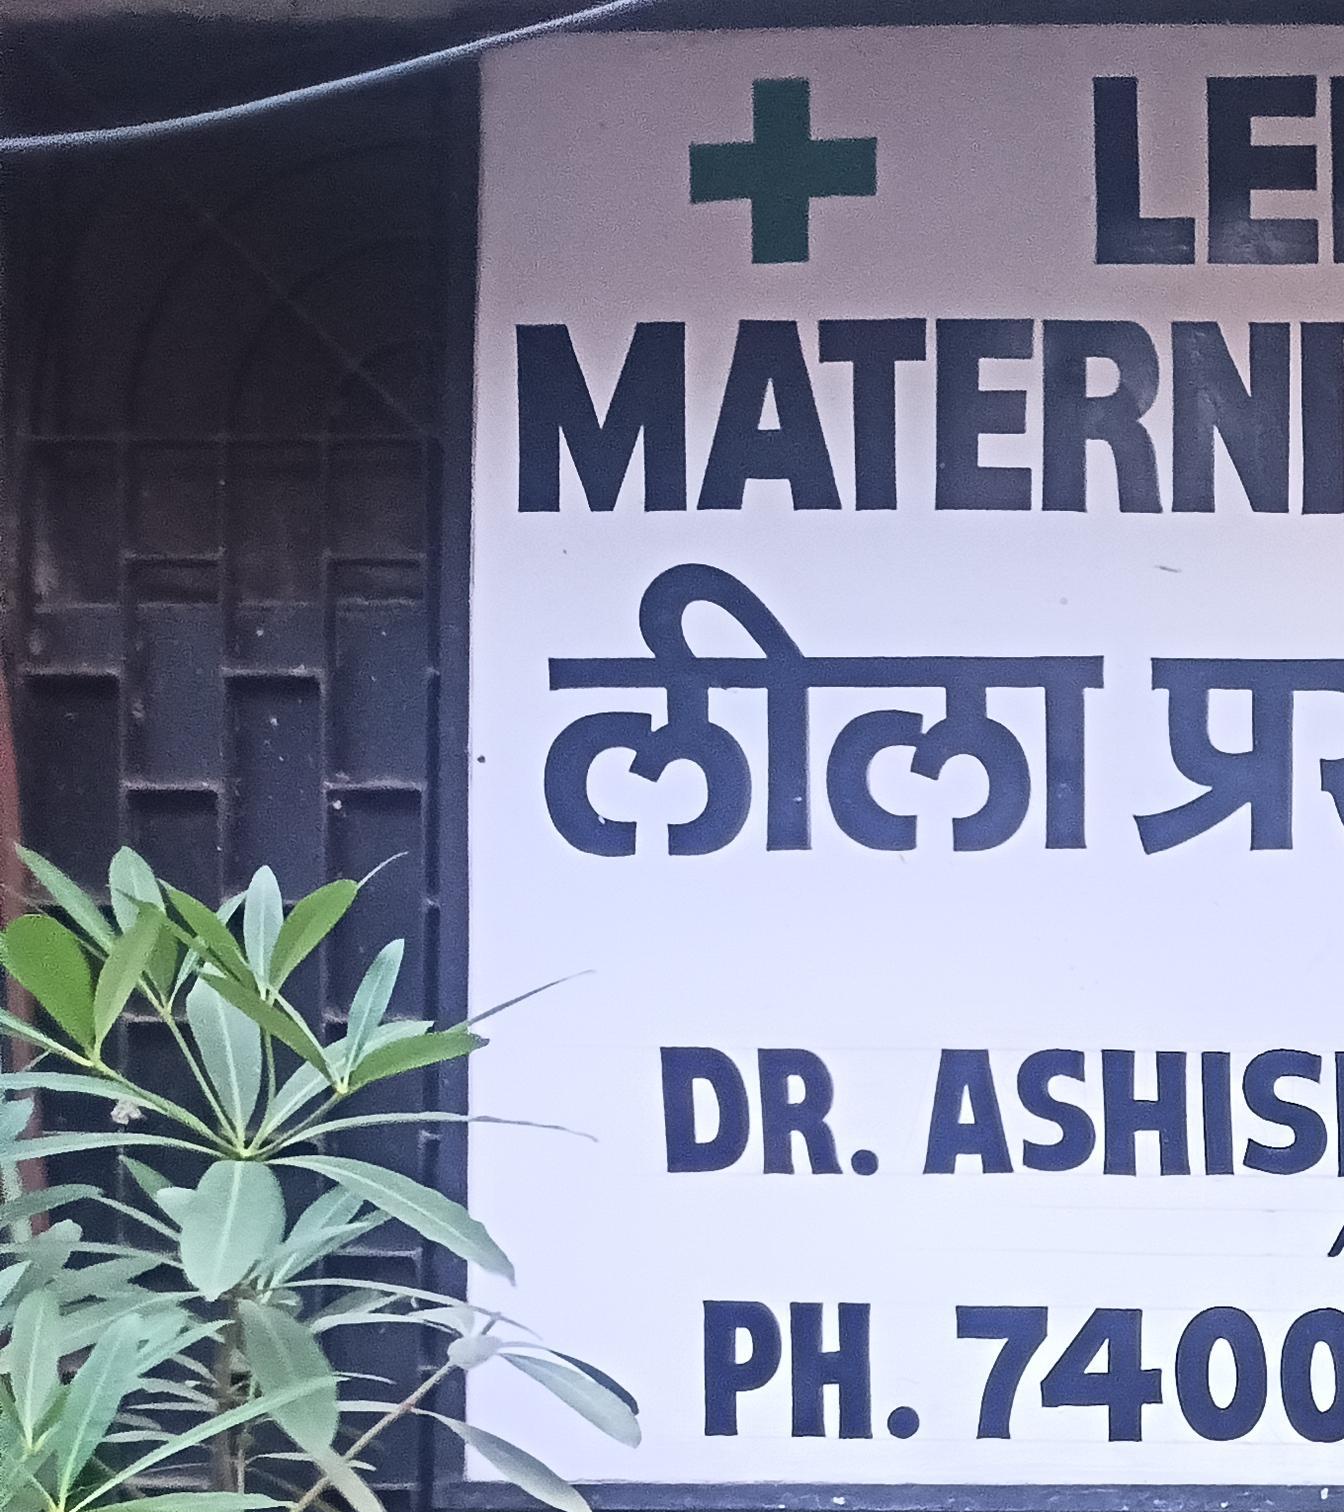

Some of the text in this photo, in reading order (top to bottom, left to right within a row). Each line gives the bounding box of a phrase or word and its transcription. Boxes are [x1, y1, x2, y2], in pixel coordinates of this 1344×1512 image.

[544, 564, 1104, 857] लीला
[660, 1047, 877, 1175] DR.
[703, 1300, 919, 1439] PH.
